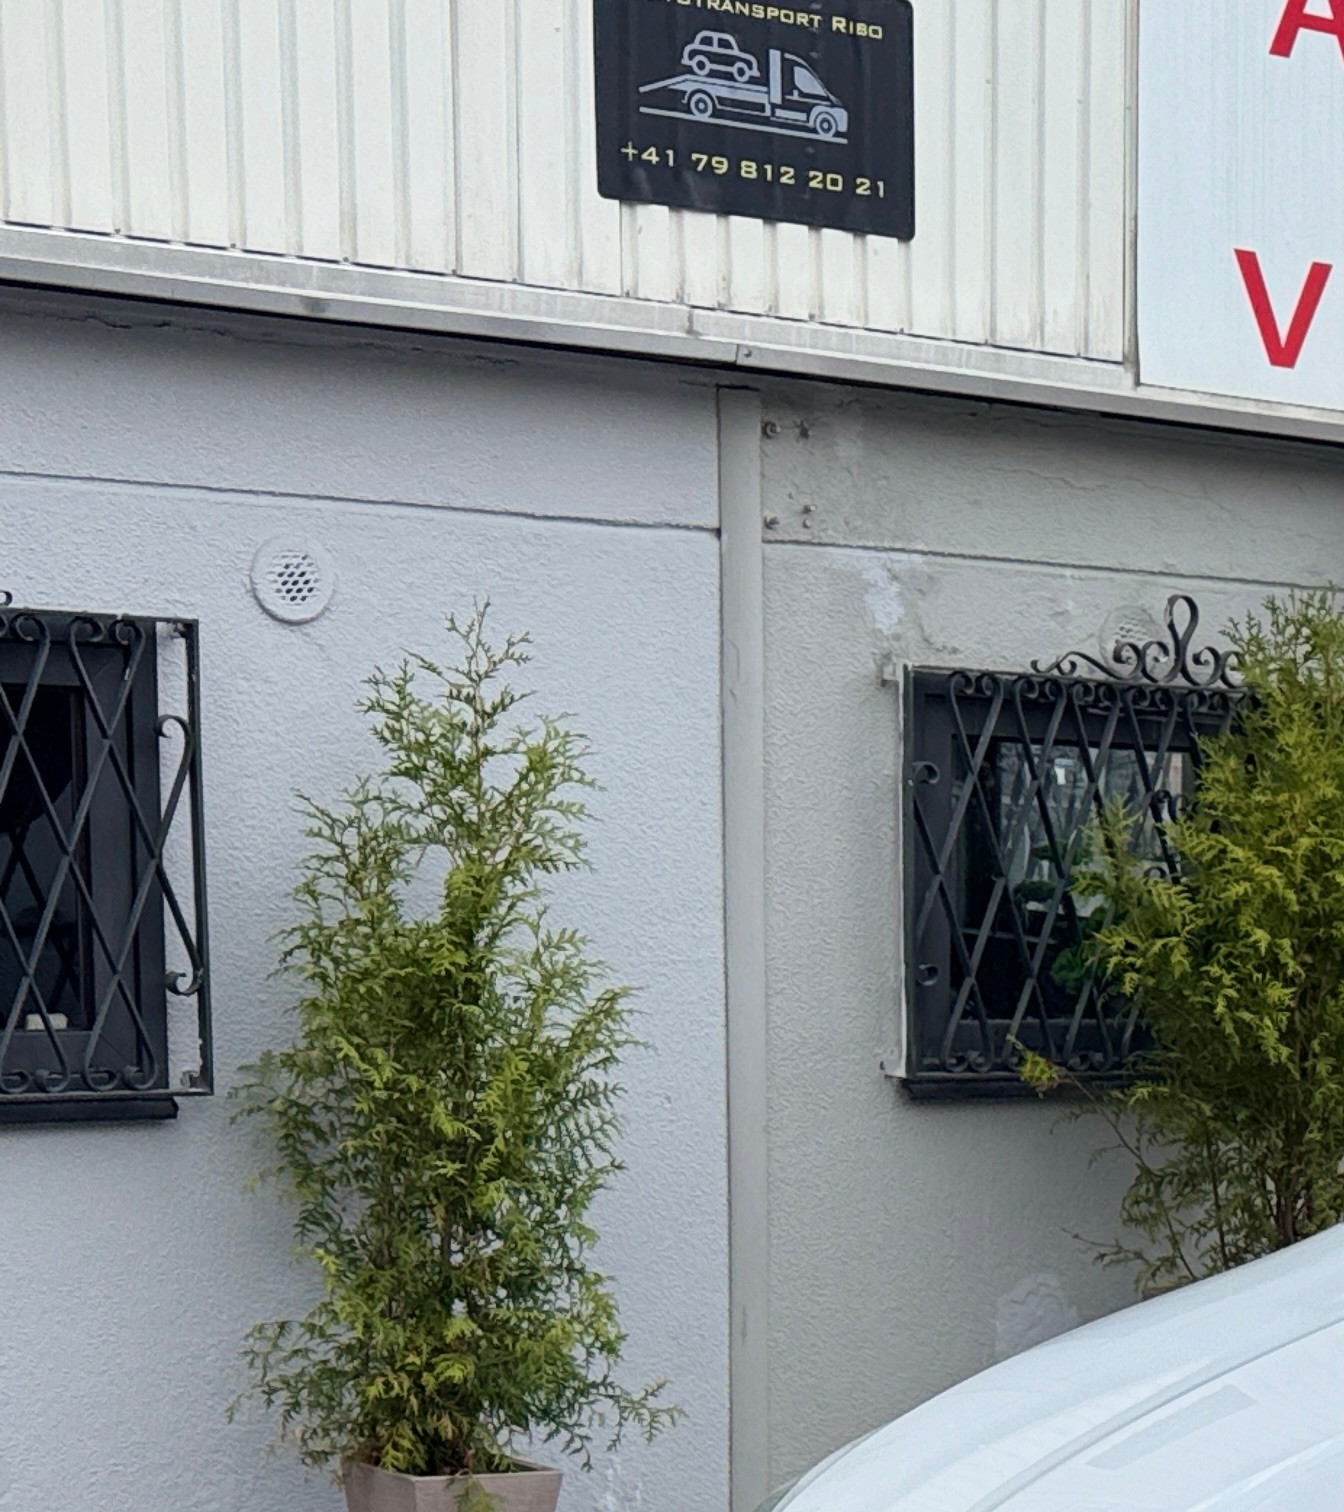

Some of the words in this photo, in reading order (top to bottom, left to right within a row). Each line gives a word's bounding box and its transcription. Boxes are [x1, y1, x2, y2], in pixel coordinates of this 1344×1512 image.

[620, 141, 675, 168] +41
[691, 153, 729, 175] 79
[740, 161, 796, 185] 812
[808, 171, 844, 192] 20
[855, 177, 886, 199] 21
